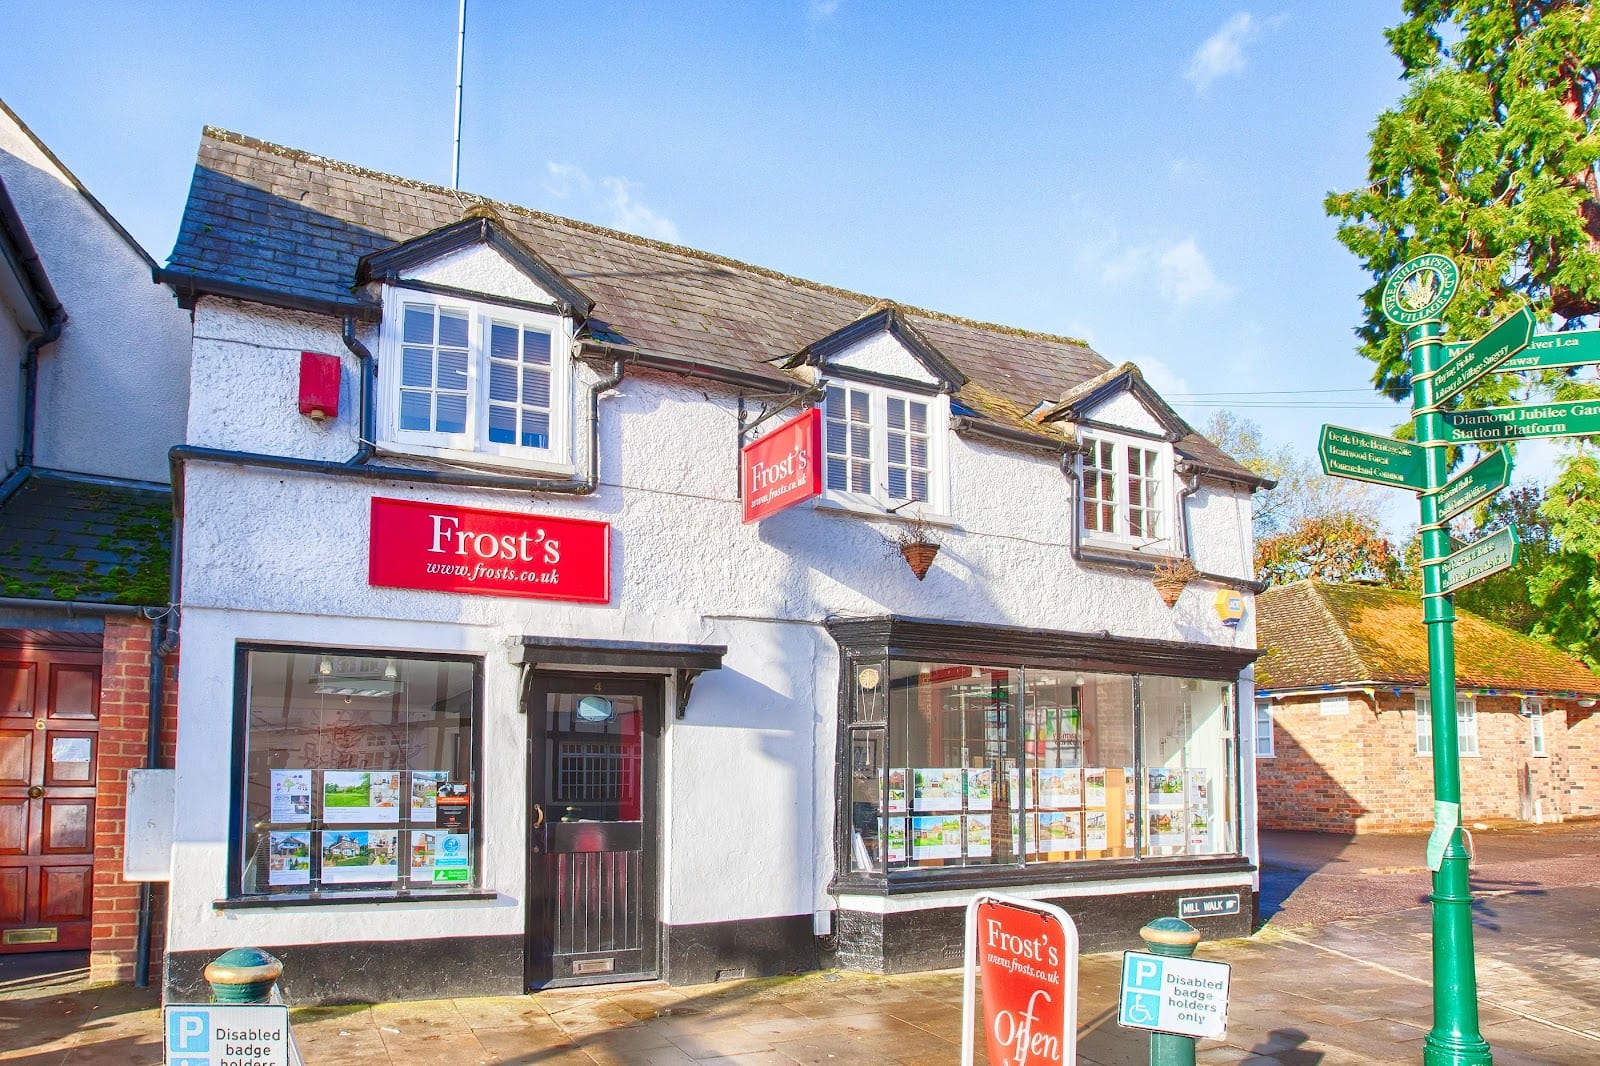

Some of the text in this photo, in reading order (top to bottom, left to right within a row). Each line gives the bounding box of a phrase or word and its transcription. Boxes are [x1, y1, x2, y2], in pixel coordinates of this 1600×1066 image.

[1386, 257, 1455, 312] WHEATHAMPSTEAD
[1400, 296, 1447, 322] VILLAGE
[1526, 338, 1579, 350] iver Lea
[1462, 362, 1483, 381] Village
[1453, 405, 1600, 426] Diamond Jubilee Gar
[1452, 422, 1566, 440] Station Platform
[751, 446, 807, 493] Frost's
[751, 473, 807, 508] www.frosts.co.uk
[427, 514, 560, 564] Frost's
[426, 561, 559, 584] www.frosts.co.uk
[594, 682, 602, 692] 4
[35, 718, 46, 730] 6
[1183, 900, 1223, 914] MILL WALK
[986, 918, 1059, 967] Frost's
[987, 952, 1060, 985] www.frosts.co.uk
[1135, 960, 1157, 986] P
[1166, 973, 1223, 991] Disabled
[1174, 985, 1213, 1001] badge
[1168, 996, 1217, 1013] holders
[1177, 1012, 1205, 1025] only
[178, 1015, 203, 1049] P
[216, 1028, 280, 1041] Disabled
[226, 1043, 271, 1058] badge
